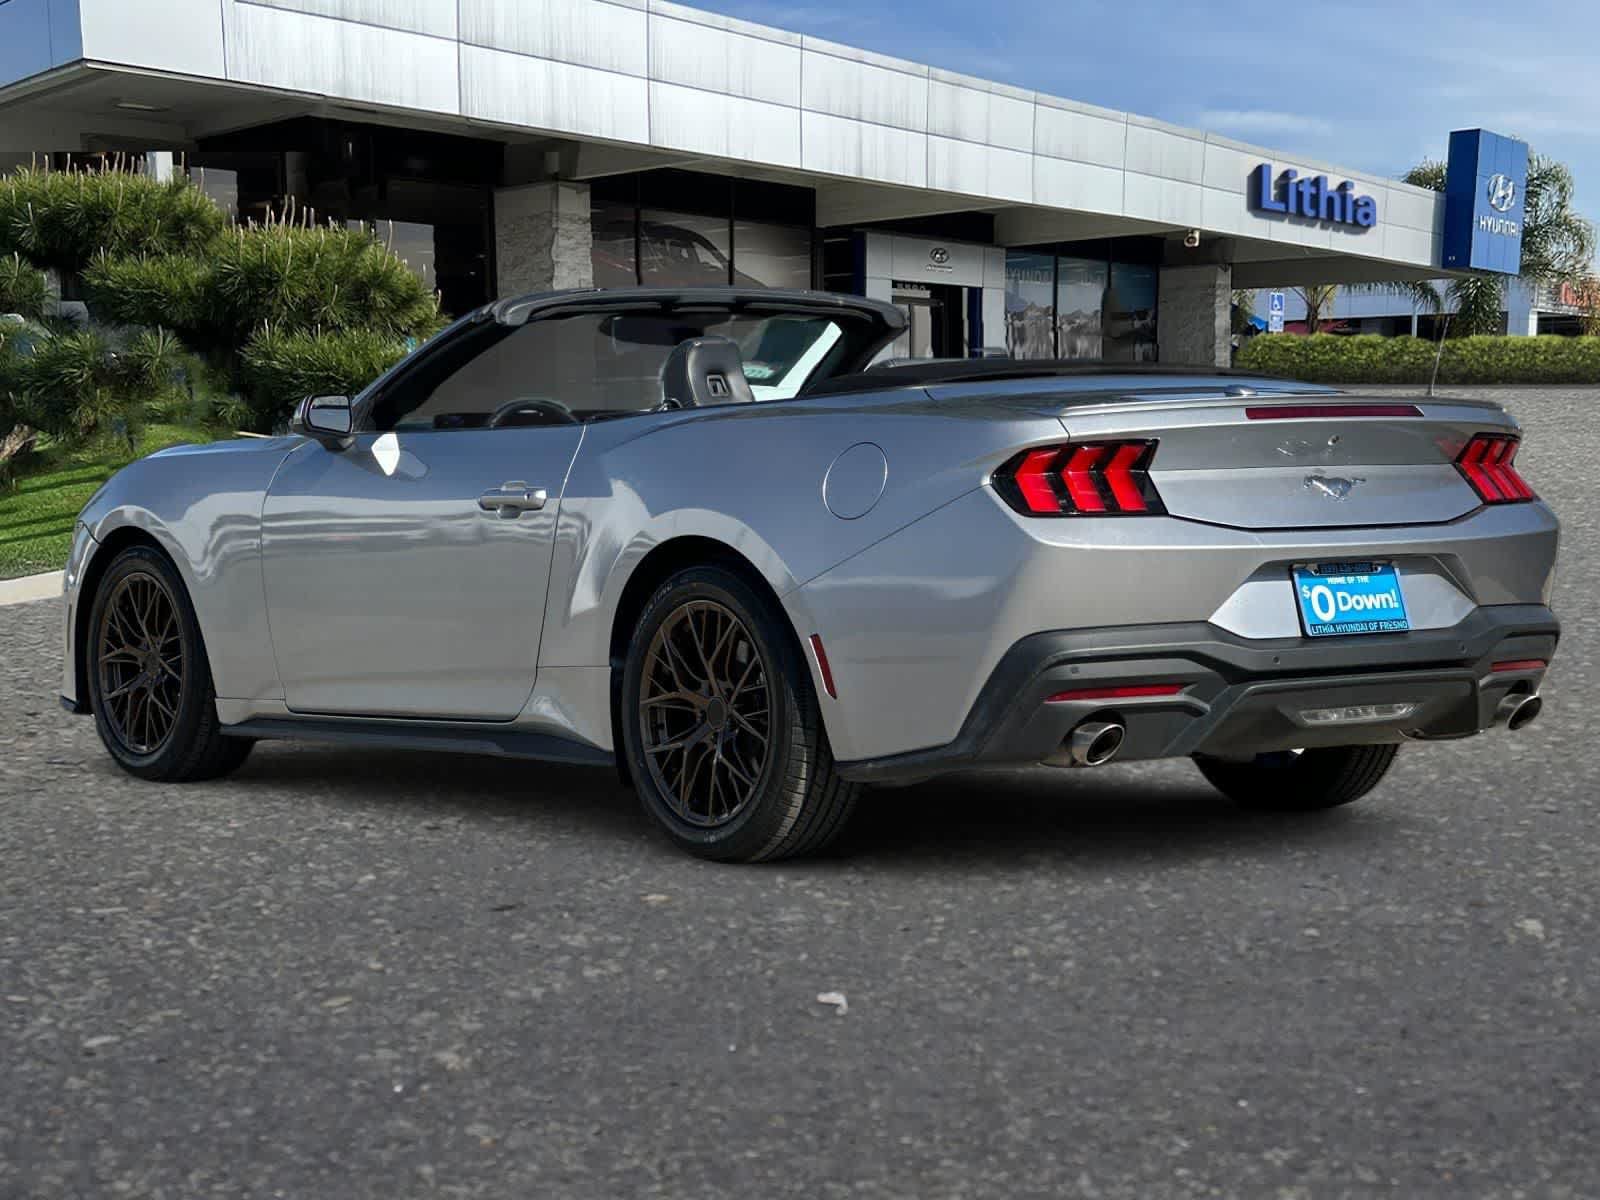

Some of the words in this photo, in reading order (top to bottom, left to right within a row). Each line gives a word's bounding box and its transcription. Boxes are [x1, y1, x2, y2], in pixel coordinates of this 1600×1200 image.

[1252, 163, 1377, 228] Lithia
[1337, 588, 1400, 612] Down!
[1336, 623, 1368, 633] HYUNDAI
[1369, 622, 1378, 631] OF
[1379, 620, 1408, 630] FRESNO
